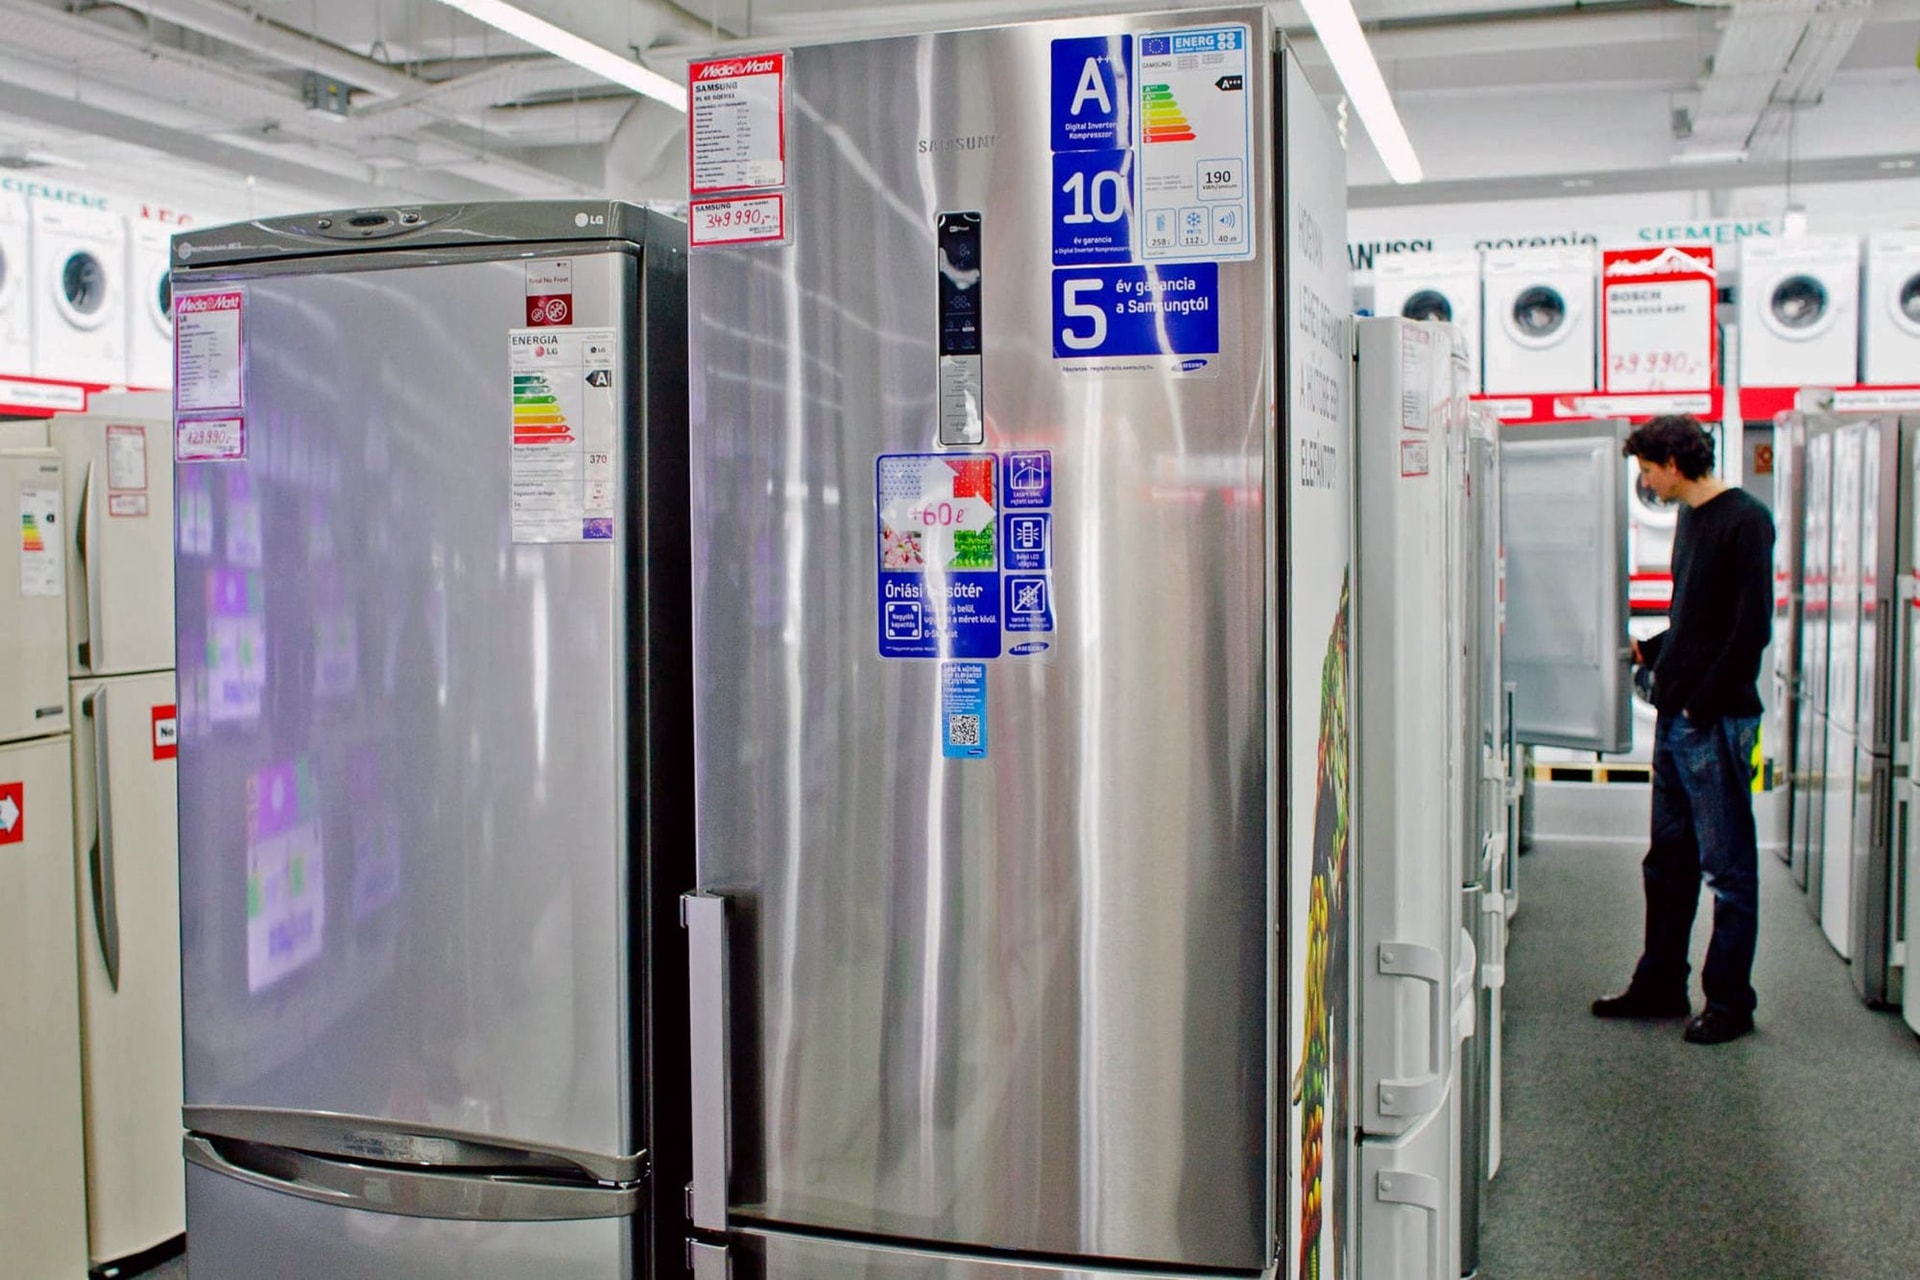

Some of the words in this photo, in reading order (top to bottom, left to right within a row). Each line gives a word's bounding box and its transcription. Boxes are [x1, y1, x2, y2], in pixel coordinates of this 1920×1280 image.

[1175, 35, 1215, 48] ENERG
[698, 64, 734, 79] Media
[741, 59, 774, 74] Markt
[695, 81, 738, 93] SAMSUNG
[1206, 170, 1231, 184] 190
[1062, 170, 1125, 224] 10
[695, 202, 732, 214] SAMSUNG
[590, 214, 604, 225] LG
[1638, 221, 1773, 244] SIEMENS
[1185, 236, 1200, 245] 112
[1116, 279, 1132, 293] év
[1136, 277, 1196, 296] gaancia
[1115, 302, 1124, 313] a
[1128, 297, 1208, 315] Samungtól
[1062, 278, 1107, 350] 5
[512, 335, 559, 346] ENERGIA
[546, 347, 559, 356] LG
[590, 454, 608, 464] 370
[885, 580, 922, 598] Óriási
[160, 727, 174, 738] No
